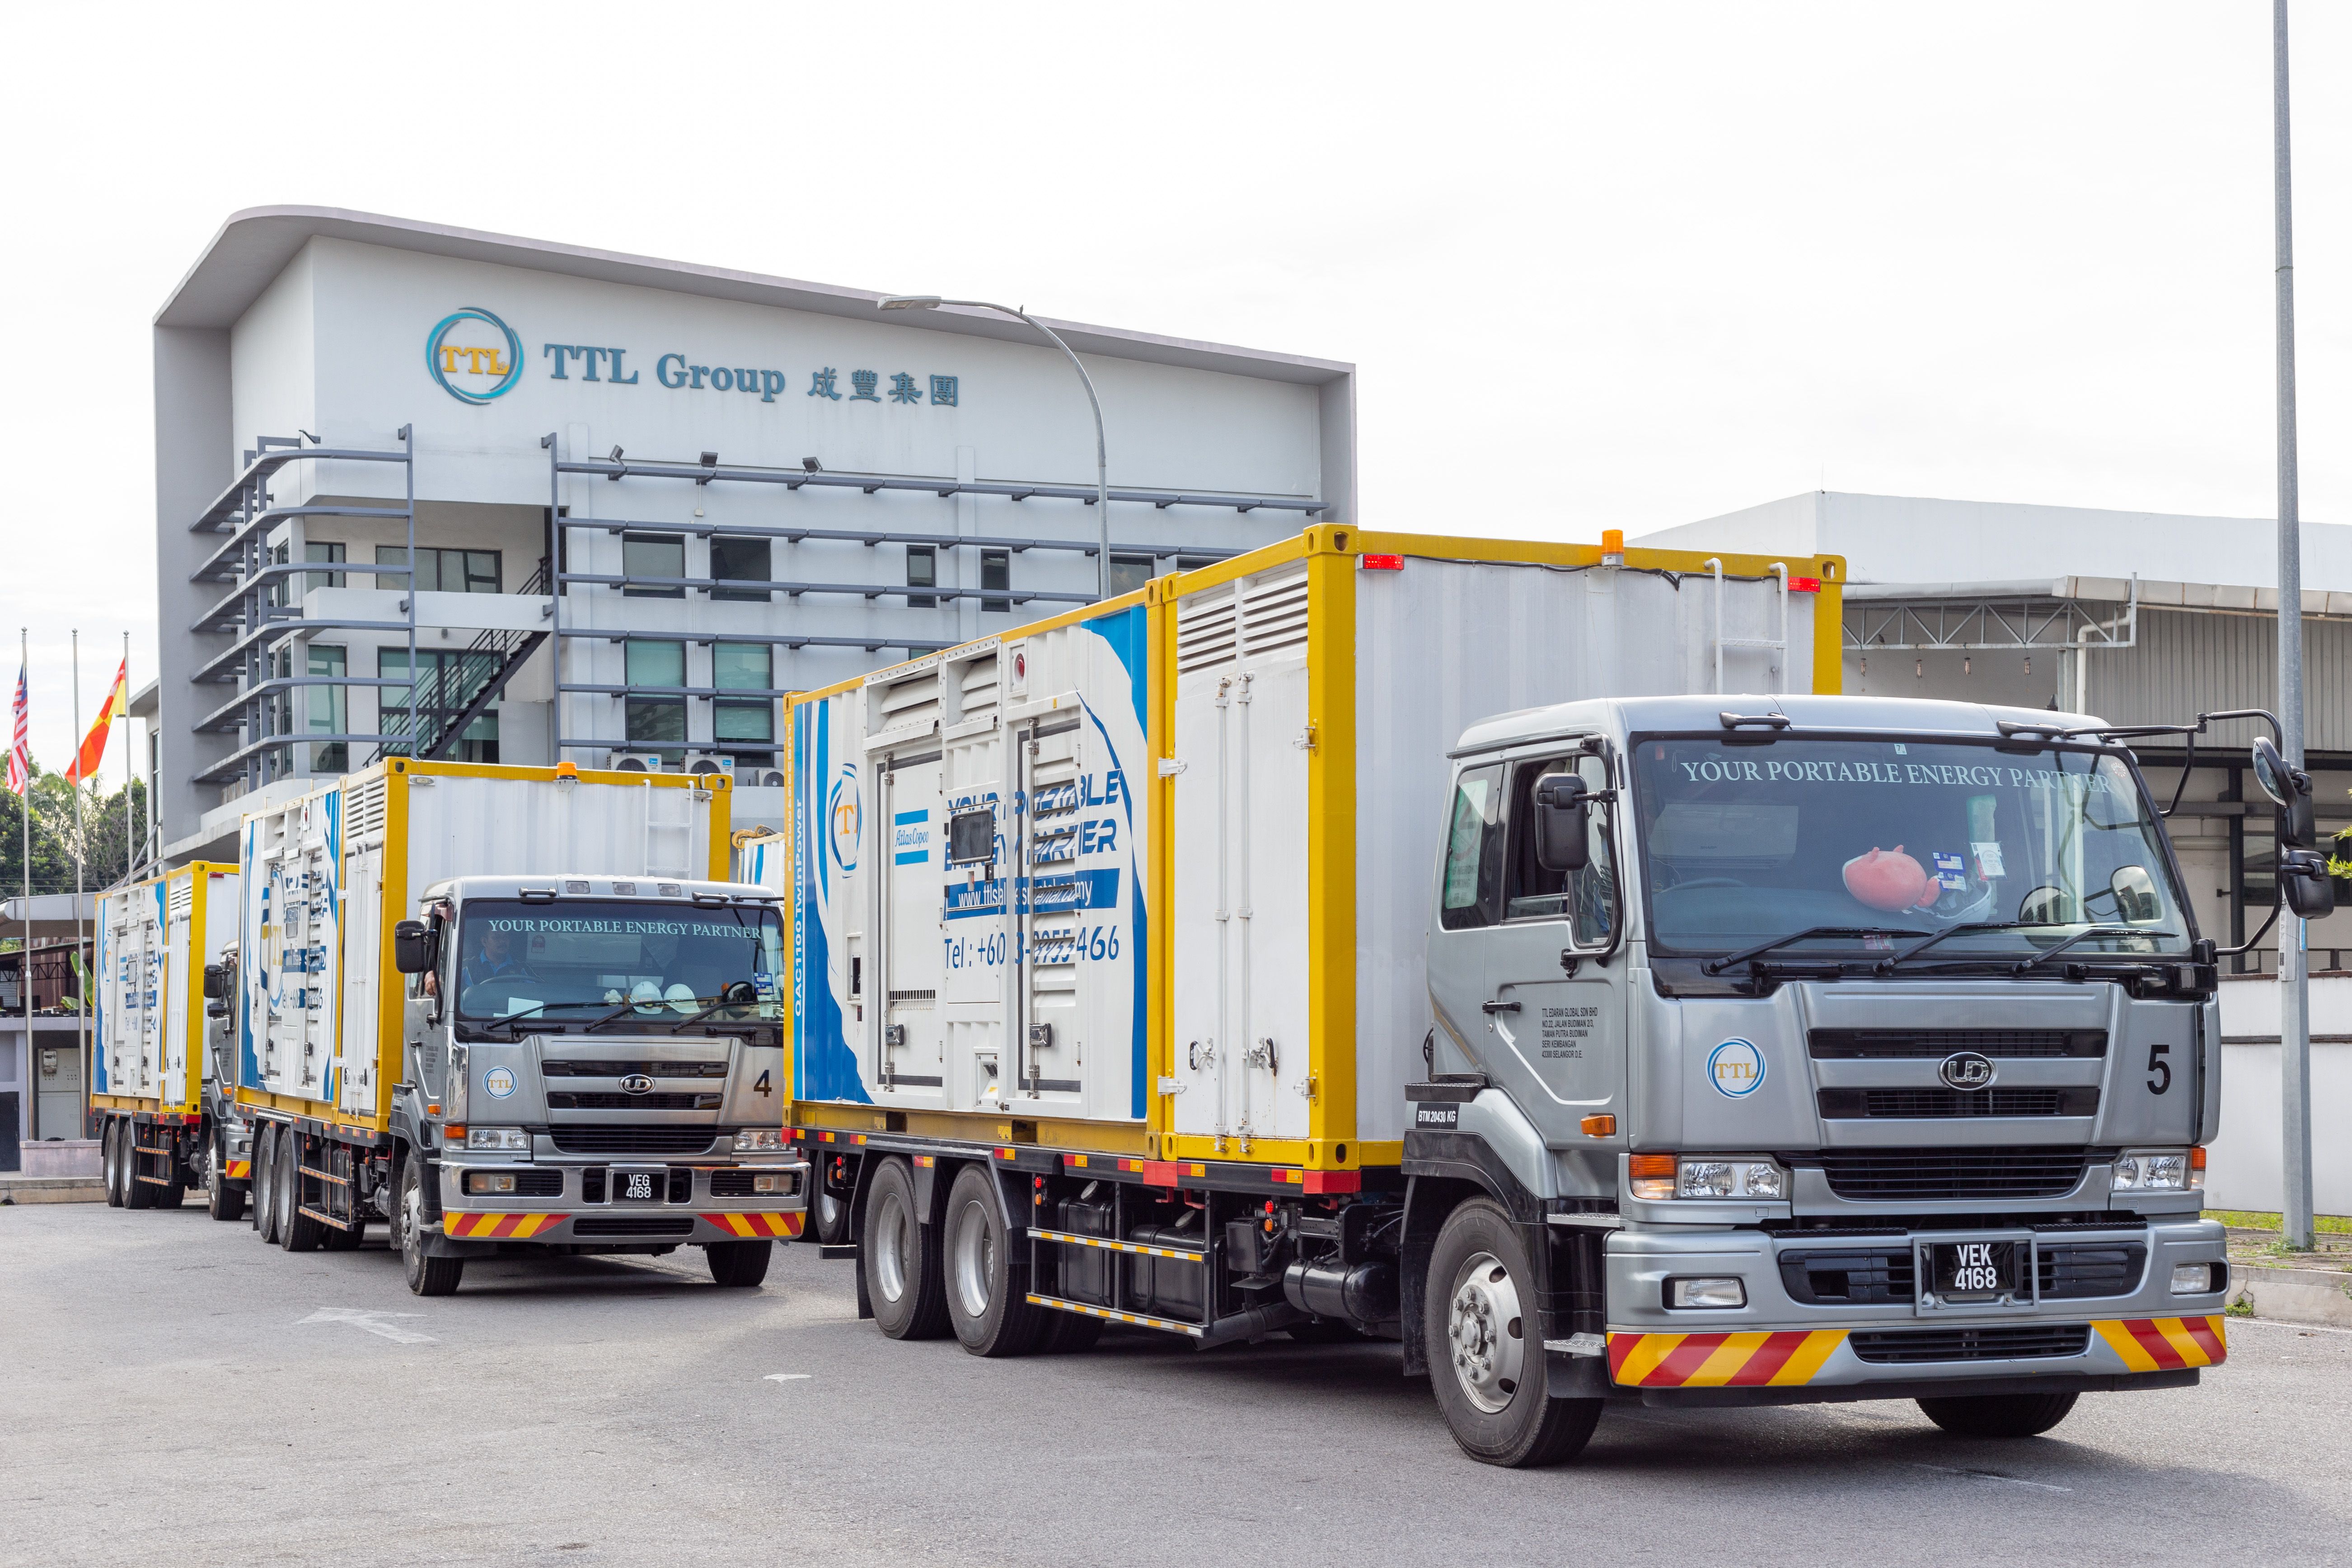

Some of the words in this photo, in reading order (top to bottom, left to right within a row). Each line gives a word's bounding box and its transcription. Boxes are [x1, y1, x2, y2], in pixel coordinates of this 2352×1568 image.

[439, 346, 510, 375] TTL
[544, 343, 638, 384] TTL
[657, 353, 785, 402] Group
[808, 367, 958, 407] 成豐集團
[1680, 761, 1763, 781] YOUR
[1766, 761, 1902, 783] PORTABLE
[1904, 764, 2003, 786] ENERGY
[2008, 768, 2115, 793] PARTNER
[895, 829, 912, 847] Atlas
[913, 828, 929, 848] Copco
[488, 920, 535, 931] YOUR
[539, 920, 622, 932] PORTABLE
[625, 922, 688, 935] ENERGY
[692, 924, 761, 939] PARTNER
[945, 937, 964, 969] Tel
[1549, 1008, 1564, 1017] EDARAN
[1565, 1007, 1579, 1017] GLOBAL
[1580, 1007, 1588, 1016] SDN
[1589, 1007, 1598, 1016] BHD
[1715, 1063, 1757, 1079] TTL
[1948, 1061, 1990, 1082] UD
[2146, 1044, 2170, 1095] 5
[488, 1080, 512, 1088] TTL
[624, 1079, 651, 1091] UD
[754, 1070, 772, 1097] 4
[1418, 1110, 1430, 1122] BTM
[1430, 1111, 1446, 1123] 20430
[1447, 1110, 1456, 1122] KG
[628, 1174, 650, 1186] VEG
[626, 1186, 651, 1198] 4168
[1957, 1244, 1991, 1266] VEK
[1955, 1267, 1997, 1290] 4168
